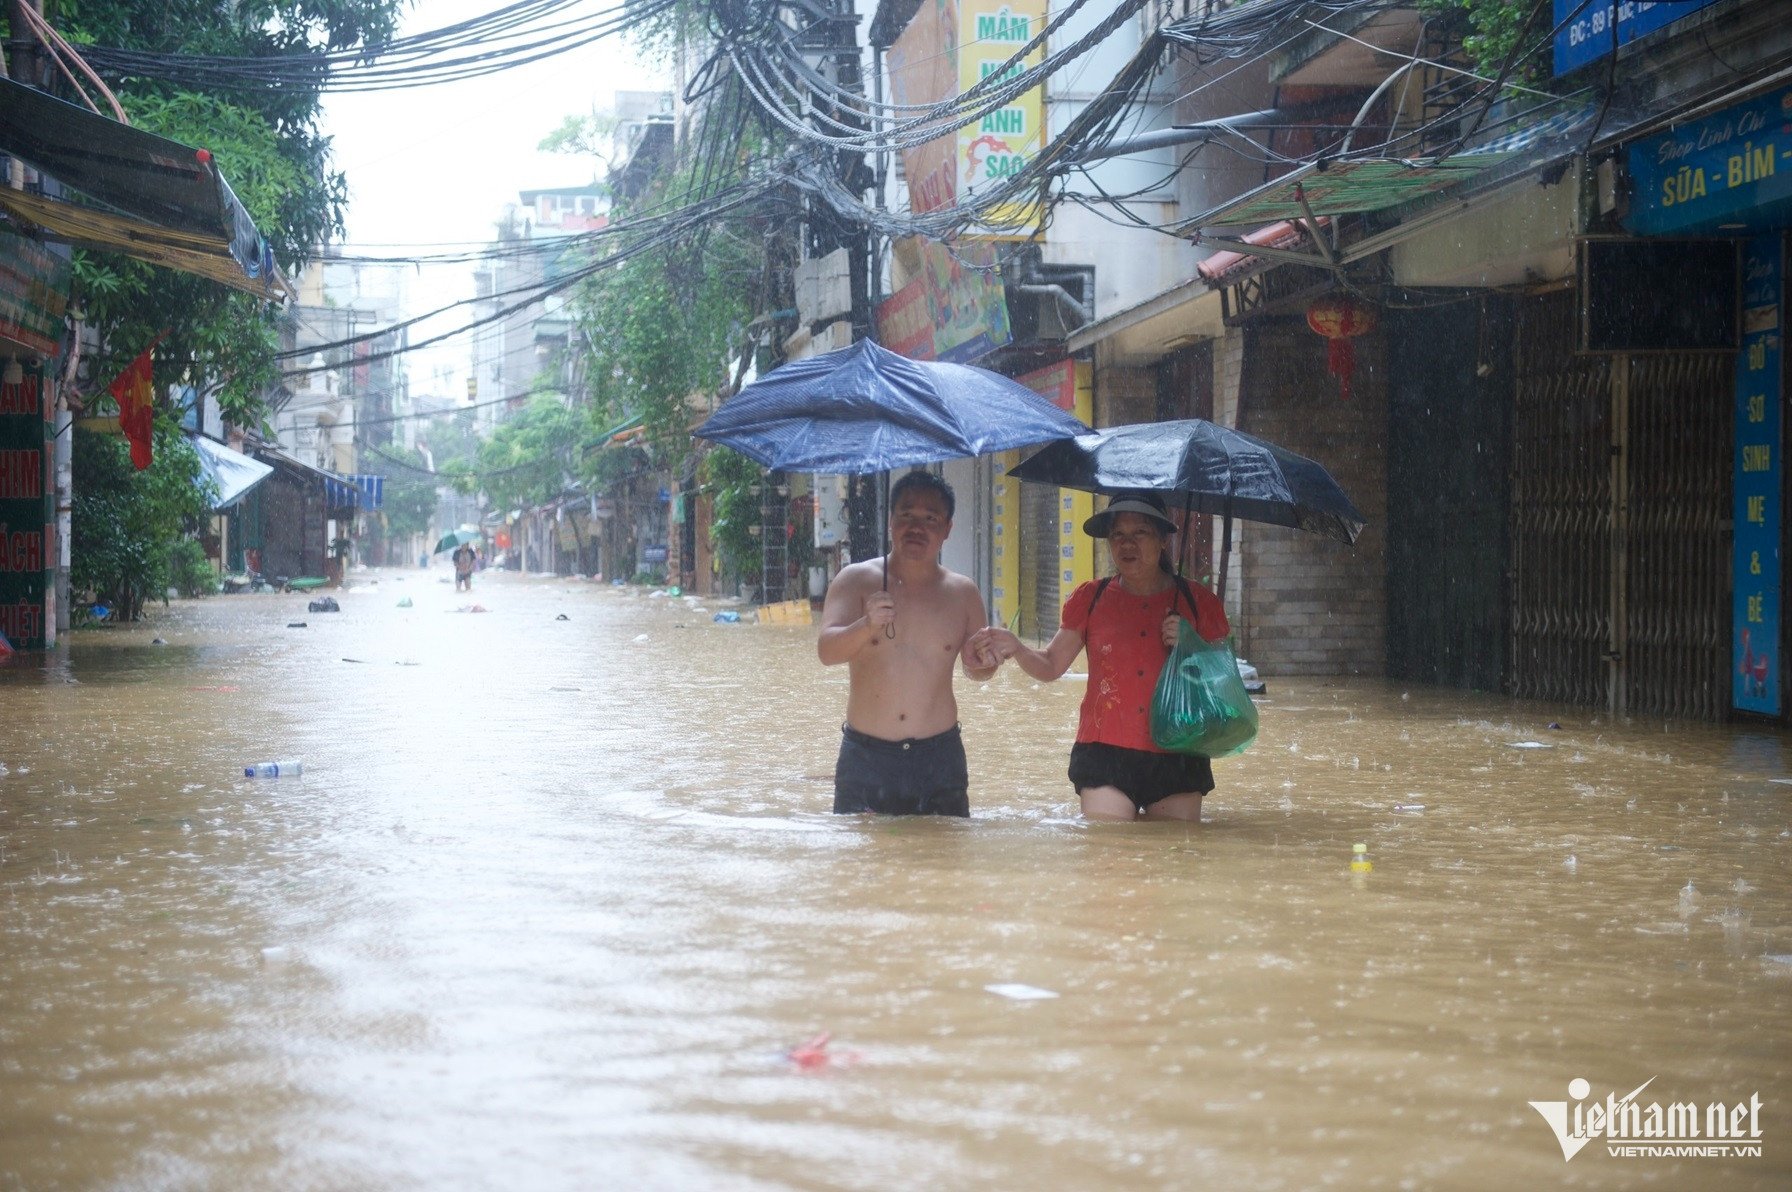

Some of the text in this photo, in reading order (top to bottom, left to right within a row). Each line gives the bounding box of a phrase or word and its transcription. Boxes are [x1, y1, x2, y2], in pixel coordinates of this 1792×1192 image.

[1592, 10, 1606, 35] 89
[1658, 108, 1767, 164] Shop Linh Chi
[986, 154, 1024, 179] SAO
[1662, 165, 1706, 207] SỮA
[1727, 140, 1775, 188] BỈM
[1743, 445, 1770, 473] SINH
[1747, 496, 1765, 528] MẸ
[1750, 550, 1761, 575] &
[1748, 590, 1763, 623] BÉ
